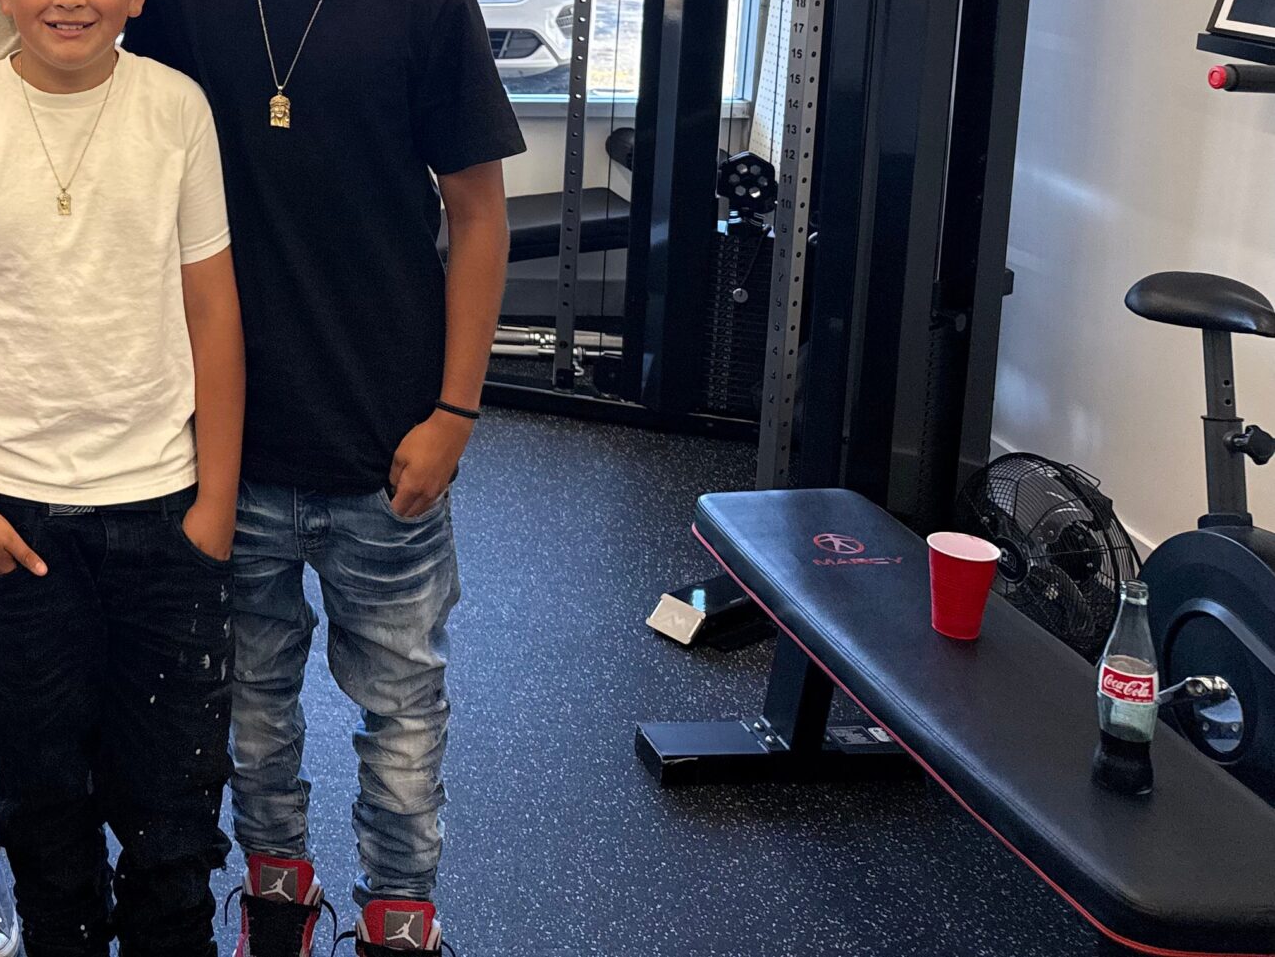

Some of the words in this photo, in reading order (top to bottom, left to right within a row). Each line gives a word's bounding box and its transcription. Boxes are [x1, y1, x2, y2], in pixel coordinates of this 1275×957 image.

[793, 23, 804, 33] 17
[790, 74, 801, 84] 15
[788, 99, 799, 109] 14
[786, 124, 797, 134] 13
[784, 149, 795, 159] 12
[782, 174, 792, 184] 11
[812, 556, 903, 566] MARCY
[1103, 674, 1152, 697] Coca-Cola
